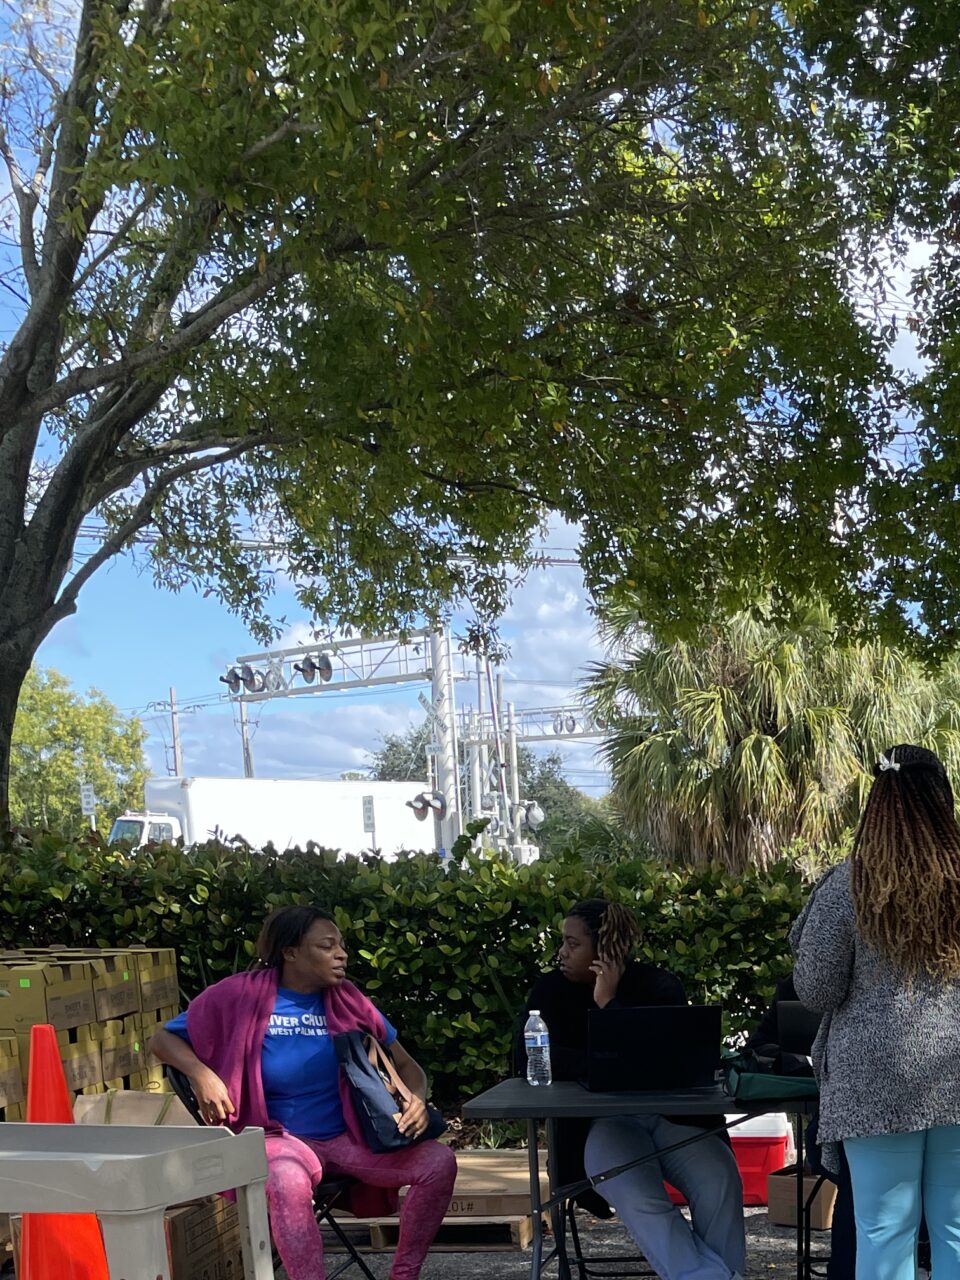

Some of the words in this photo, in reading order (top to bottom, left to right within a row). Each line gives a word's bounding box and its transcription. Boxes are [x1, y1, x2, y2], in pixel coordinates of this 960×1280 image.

[268, 1014, 299, 1026] IVER
[269, 1027, 293, 1036] WEST
[295, 1027, 315, 1036] PALM
